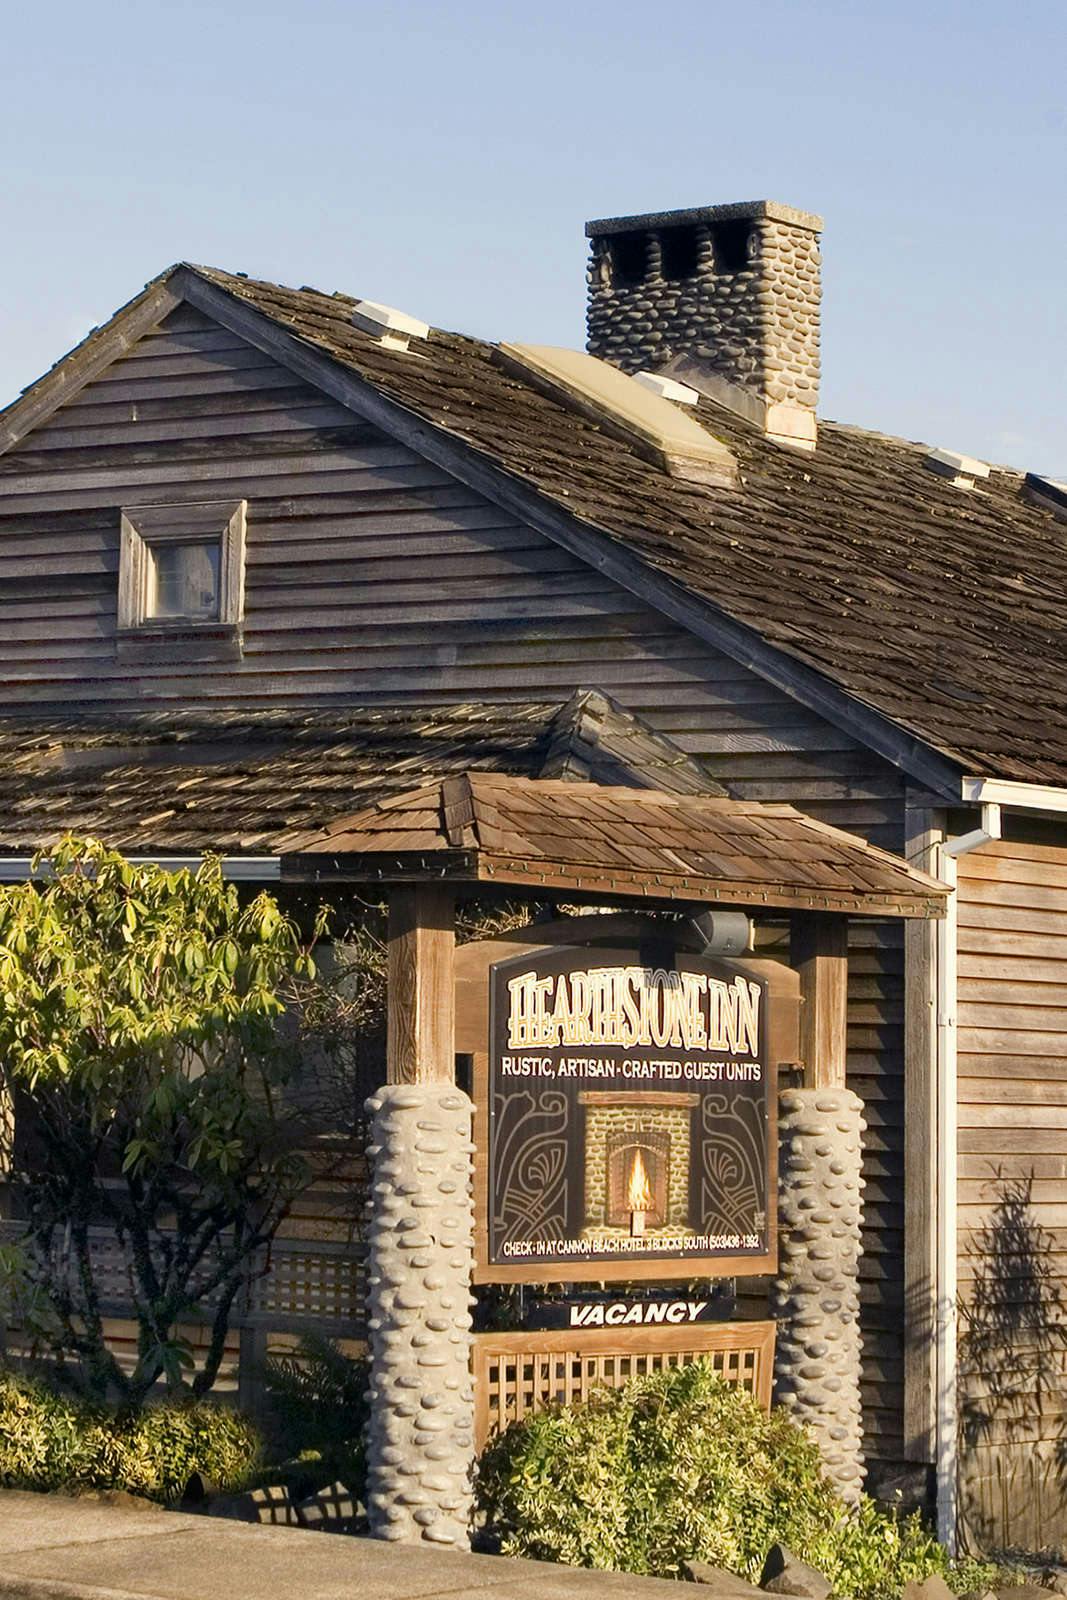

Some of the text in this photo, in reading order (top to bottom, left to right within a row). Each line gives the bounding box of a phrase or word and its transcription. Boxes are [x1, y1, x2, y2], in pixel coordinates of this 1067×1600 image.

[508, 966, 761, 1057] HEARTHSTONE INN
[502, 1057, 556, 1079] RUSTIC,
[686, 1061, 729, 1080] GUEST
[728, 1063, 761, 1081] UNITS
[546, 1239, 557, 1255] AT
[557, 1239, 592, 1254] CANNON
[593, 1238, 620, 1253] BEACH
[620, 1237, 645, 1252] HOTEL
[646, 1237, 652, 1251] 3
[653, 1236, 683, 1251] BLOCKS
[683, 1235, 709, 1250] SOUTH
[569, 1301, 708, 1326] VACANCY
